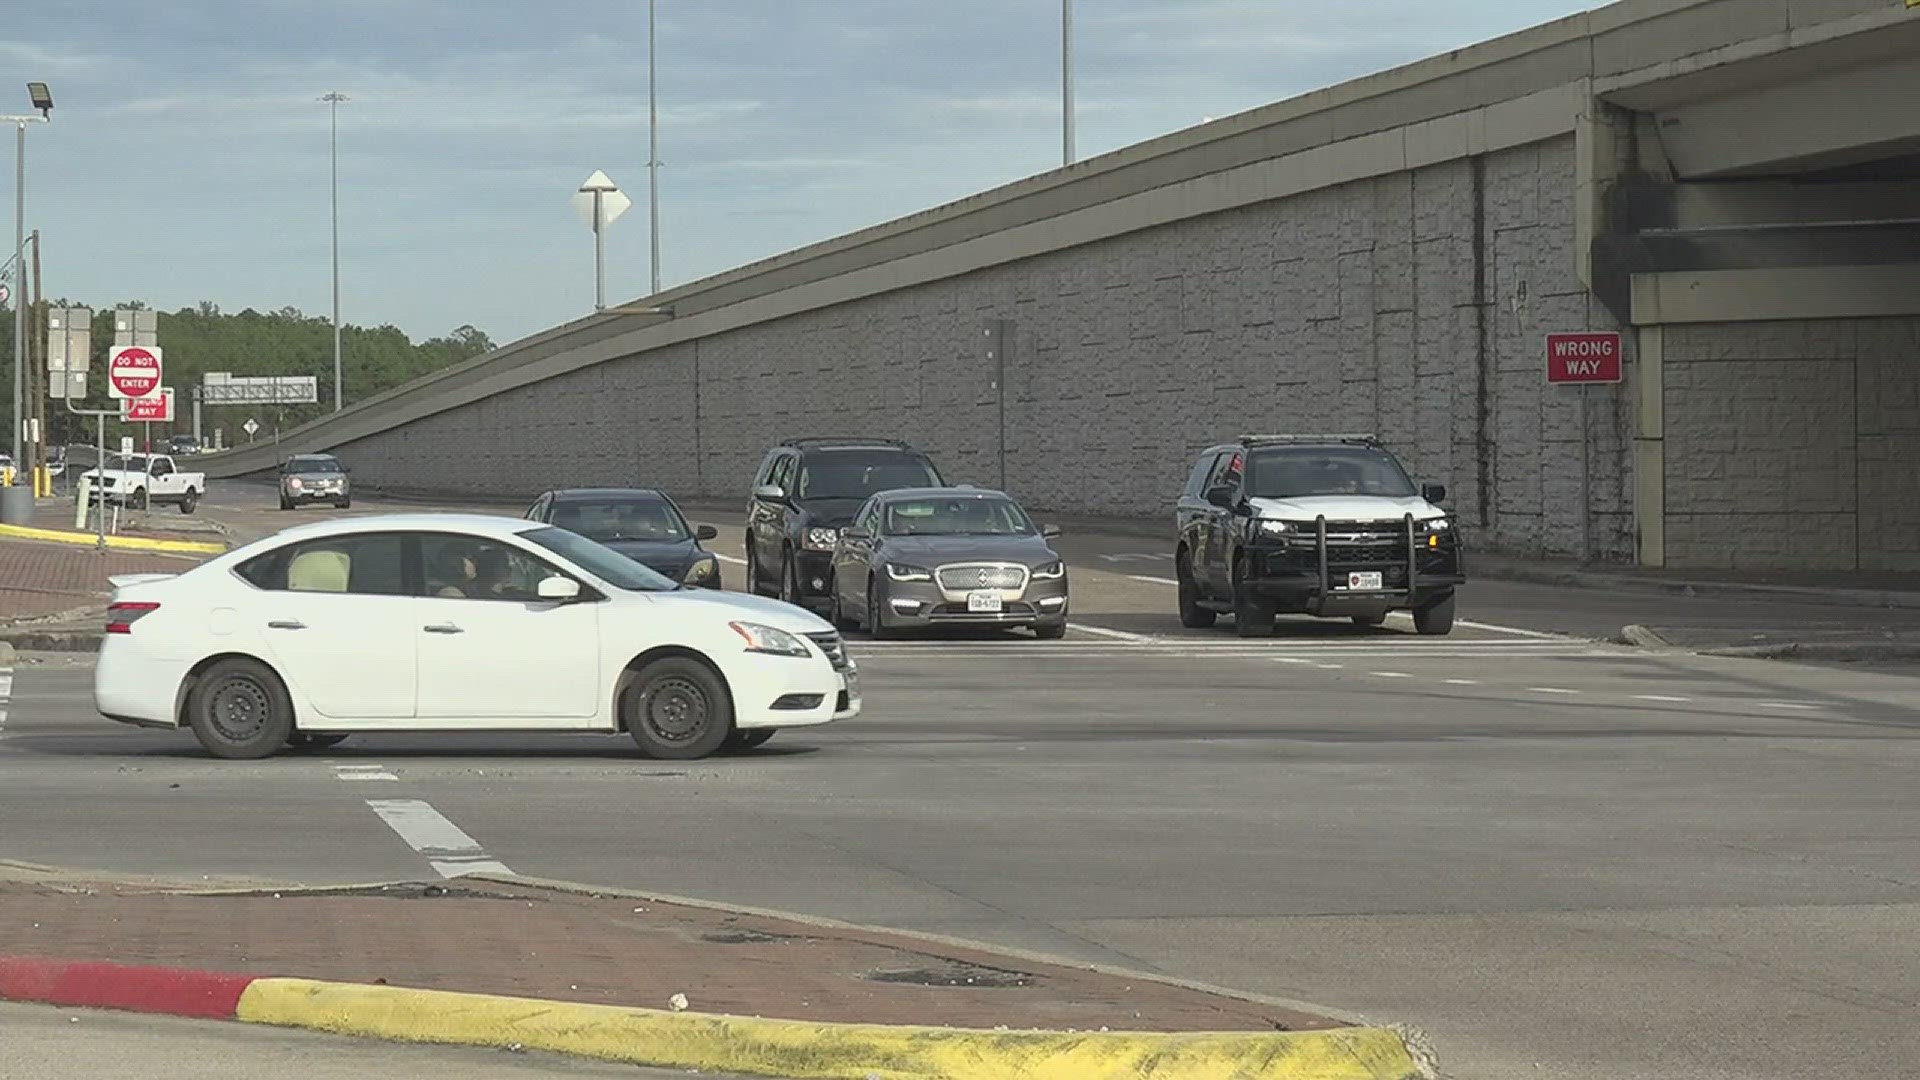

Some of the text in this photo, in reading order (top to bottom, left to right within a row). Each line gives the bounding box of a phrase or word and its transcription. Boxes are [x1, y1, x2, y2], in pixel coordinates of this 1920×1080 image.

[1555, 341, 1612, 356] WRONG
[117, 357, 153, 366] DO NOT
[1567, 361, 1600, 374] WAY
[121, 380, 149, 388] ENTER
